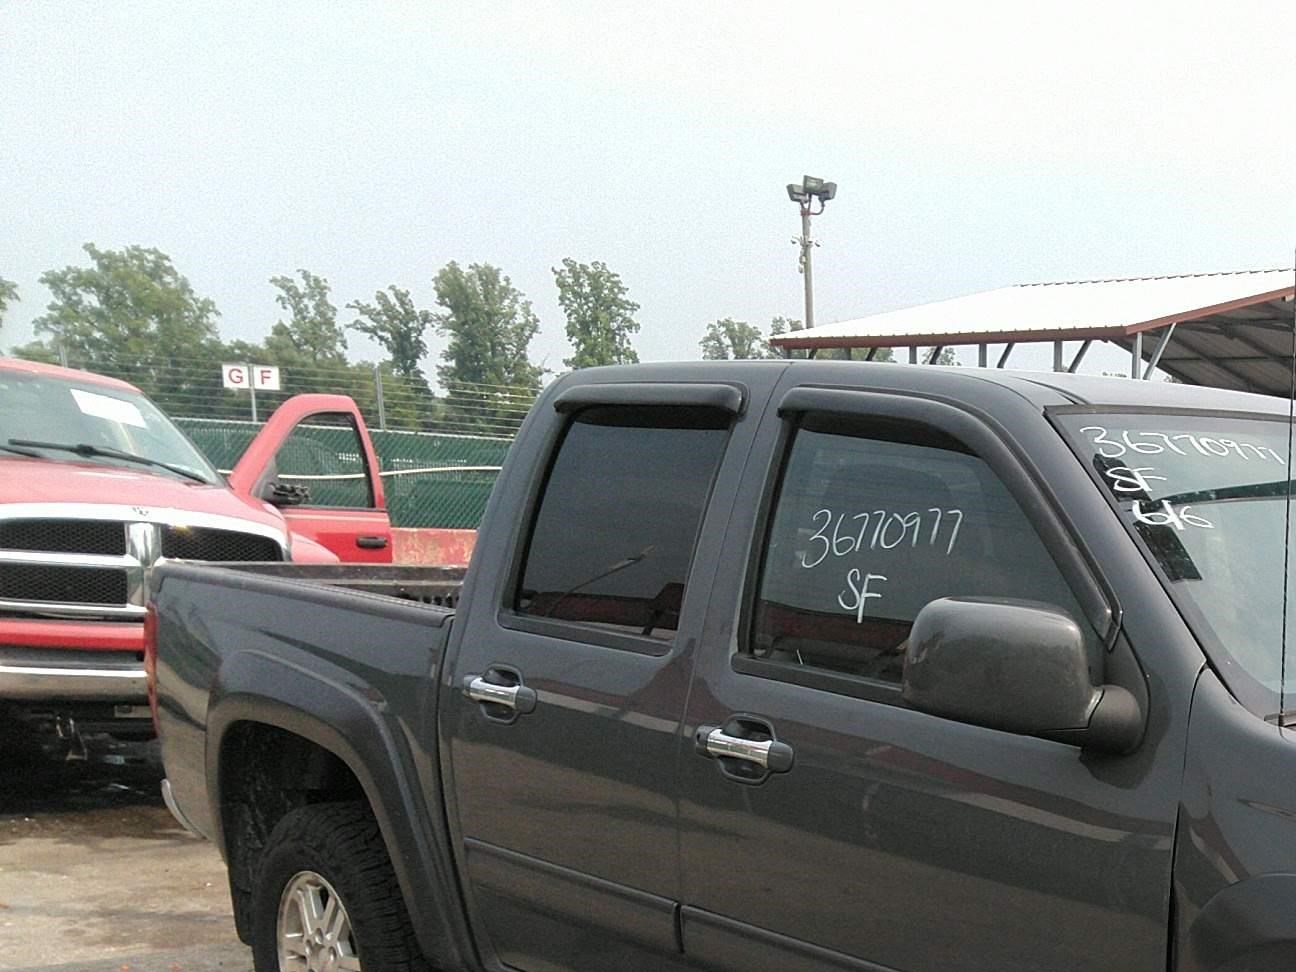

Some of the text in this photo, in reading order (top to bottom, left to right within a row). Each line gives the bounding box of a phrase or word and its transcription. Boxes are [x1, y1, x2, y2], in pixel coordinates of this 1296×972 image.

[228, 368, 272, 385] G F
[1080, 426, 1286, 465] 36770977
[1106, 467, 1168, 492] SF
[801, 507, 963, 568] 36770977
[837, 568, 888, 624] SF
